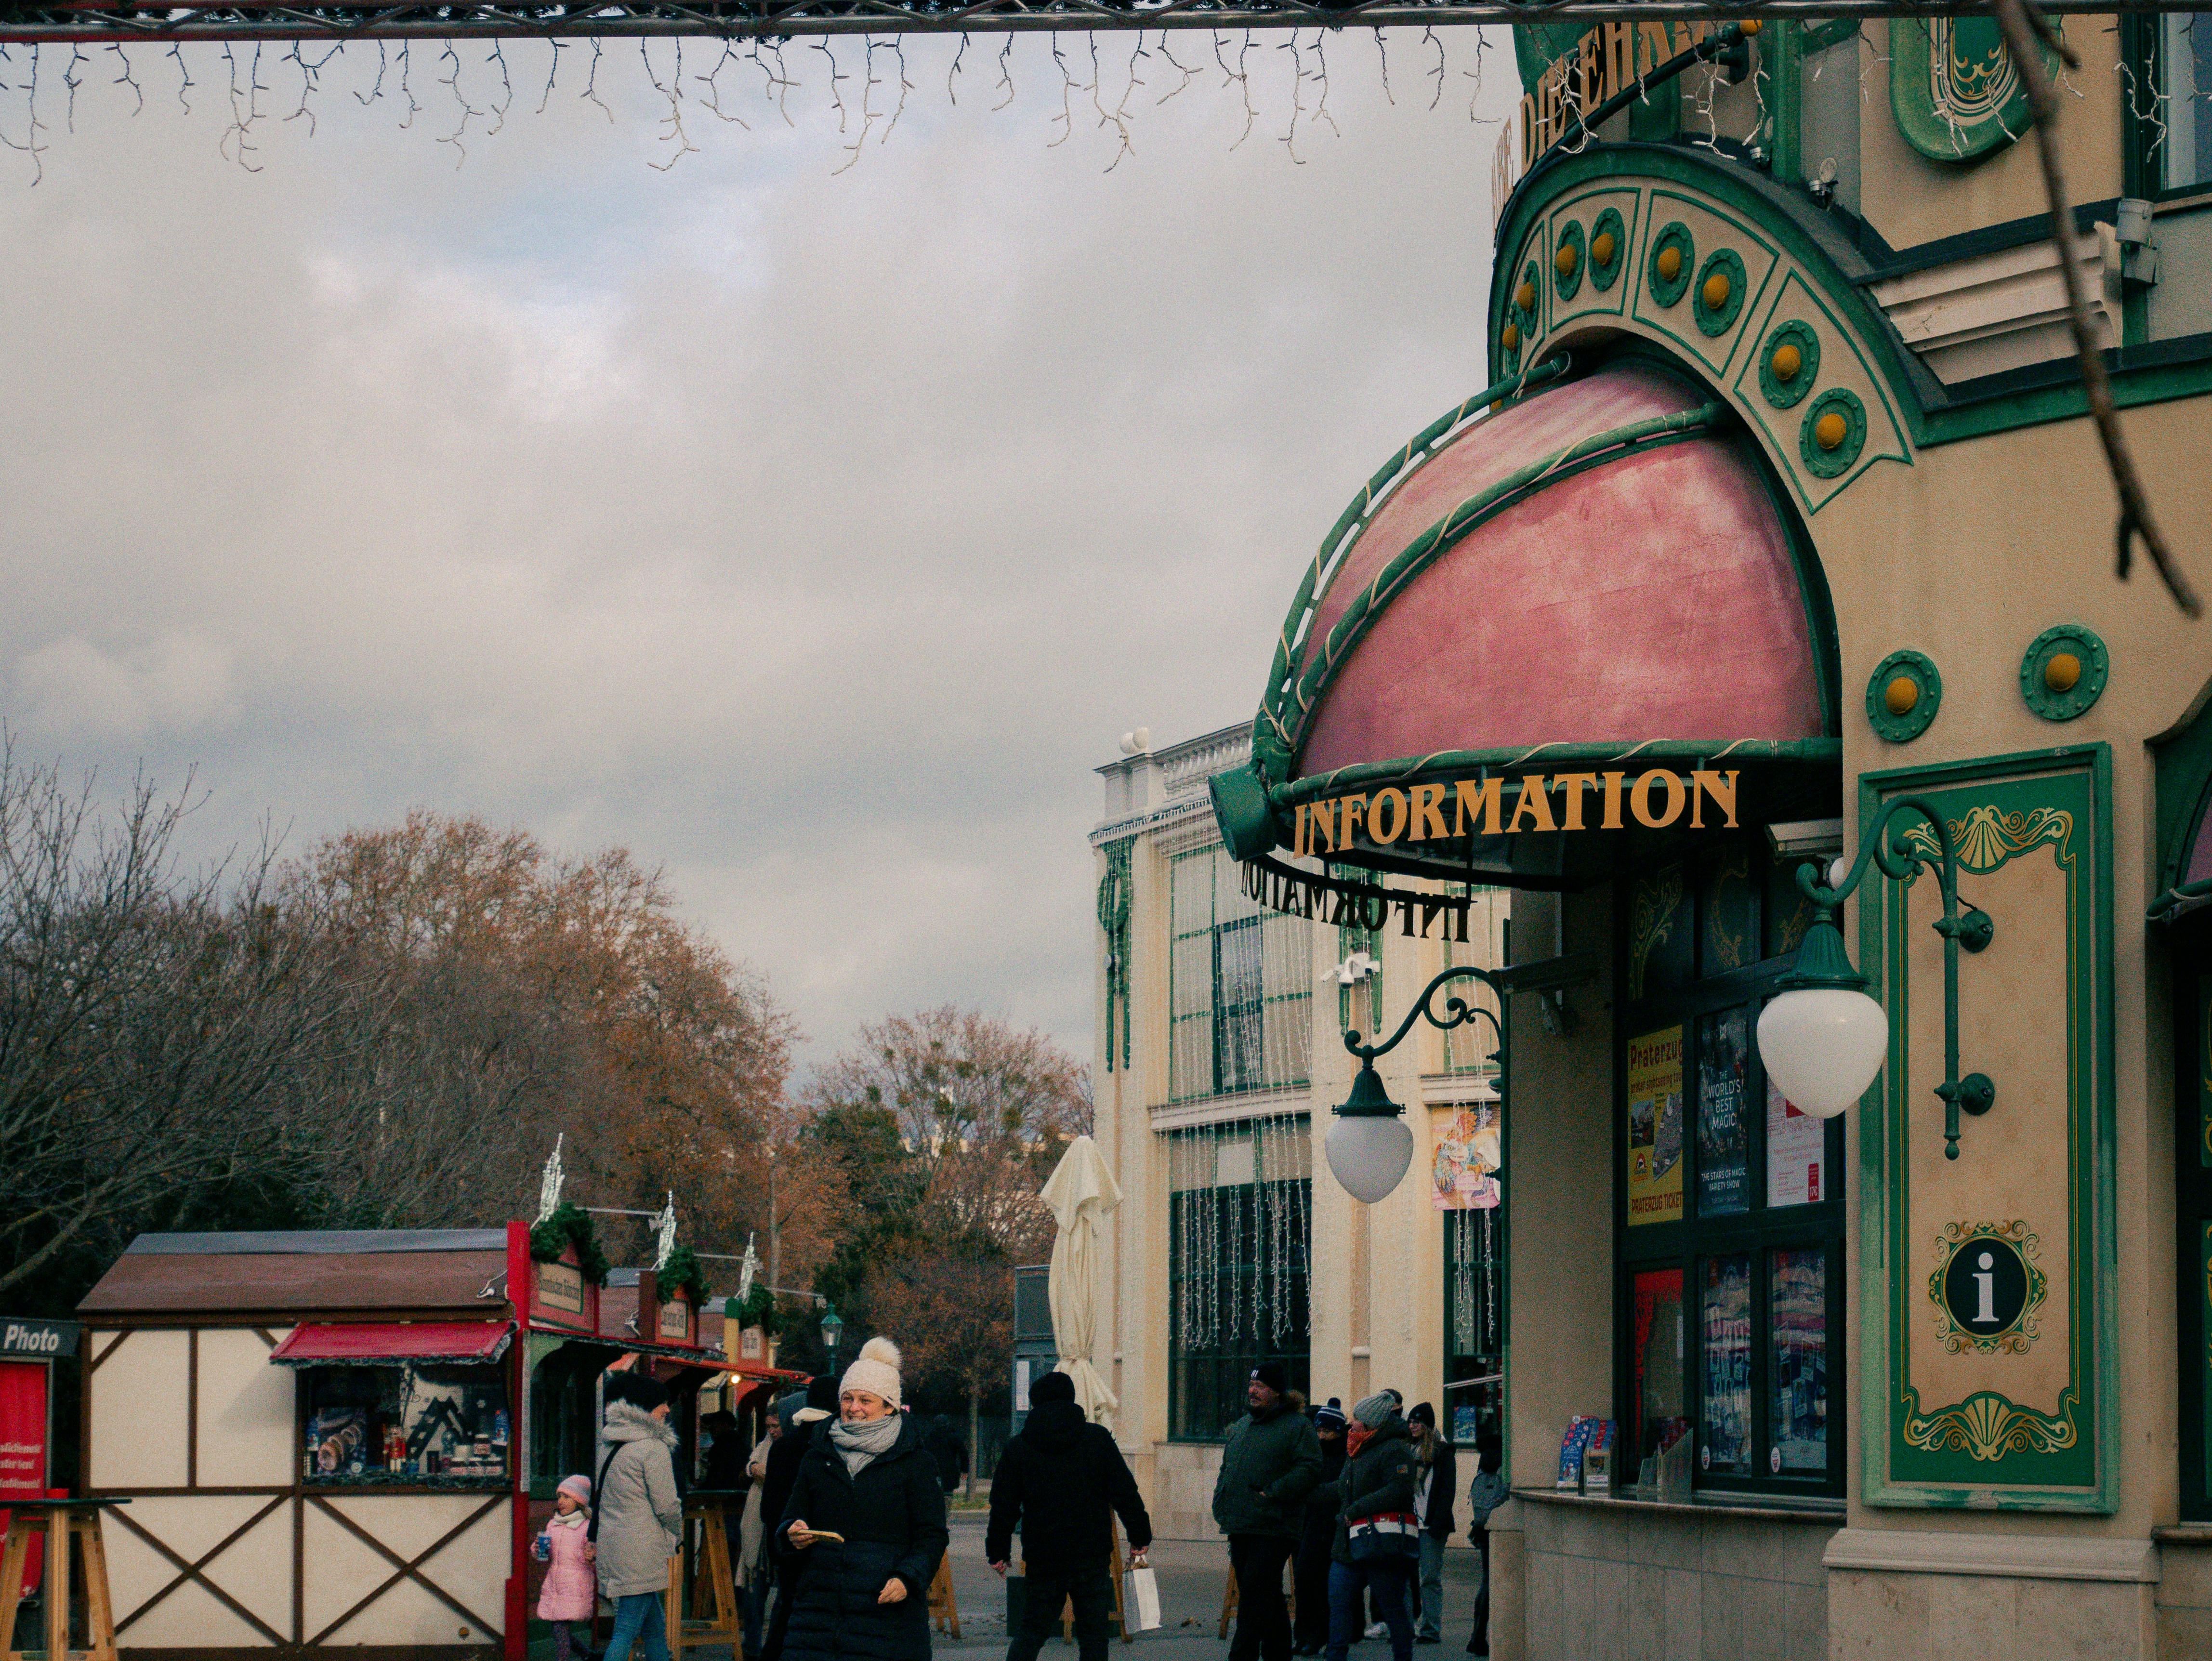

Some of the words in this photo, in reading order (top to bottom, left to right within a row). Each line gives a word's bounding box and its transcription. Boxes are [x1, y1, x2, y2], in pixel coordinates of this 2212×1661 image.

[1520, 53, 1566, 179] DIE
[1292, 769, 1740, 860] INFORMATION
[1631, 1039, 1682, 1070] Praterzug
[1719, 1070, 1728, 1079] THE
[1708, 1079, 1741, 1099] WORLD'S
[1715, 1097, 1733, 1114] BEST
[1701, 1172, 1710, 1182] THE
[1711, 1170, 1725, 1181] STARS
[1725, 1169, 1731, 1178] OF
[1731, 1167, 1746, 1177] MAGIC
[1708, 1181, 1725, 1192] VARIETY
[1726, 1179, 1740, 1189] SHOW
[1632, 1194, 1663, 1215] PRATERZUG
[1664, 1191, 1683, 1210] TICKET
[1972, 1252, 2000, 1322] i
[3, 1324, 59, 1352] Photo
